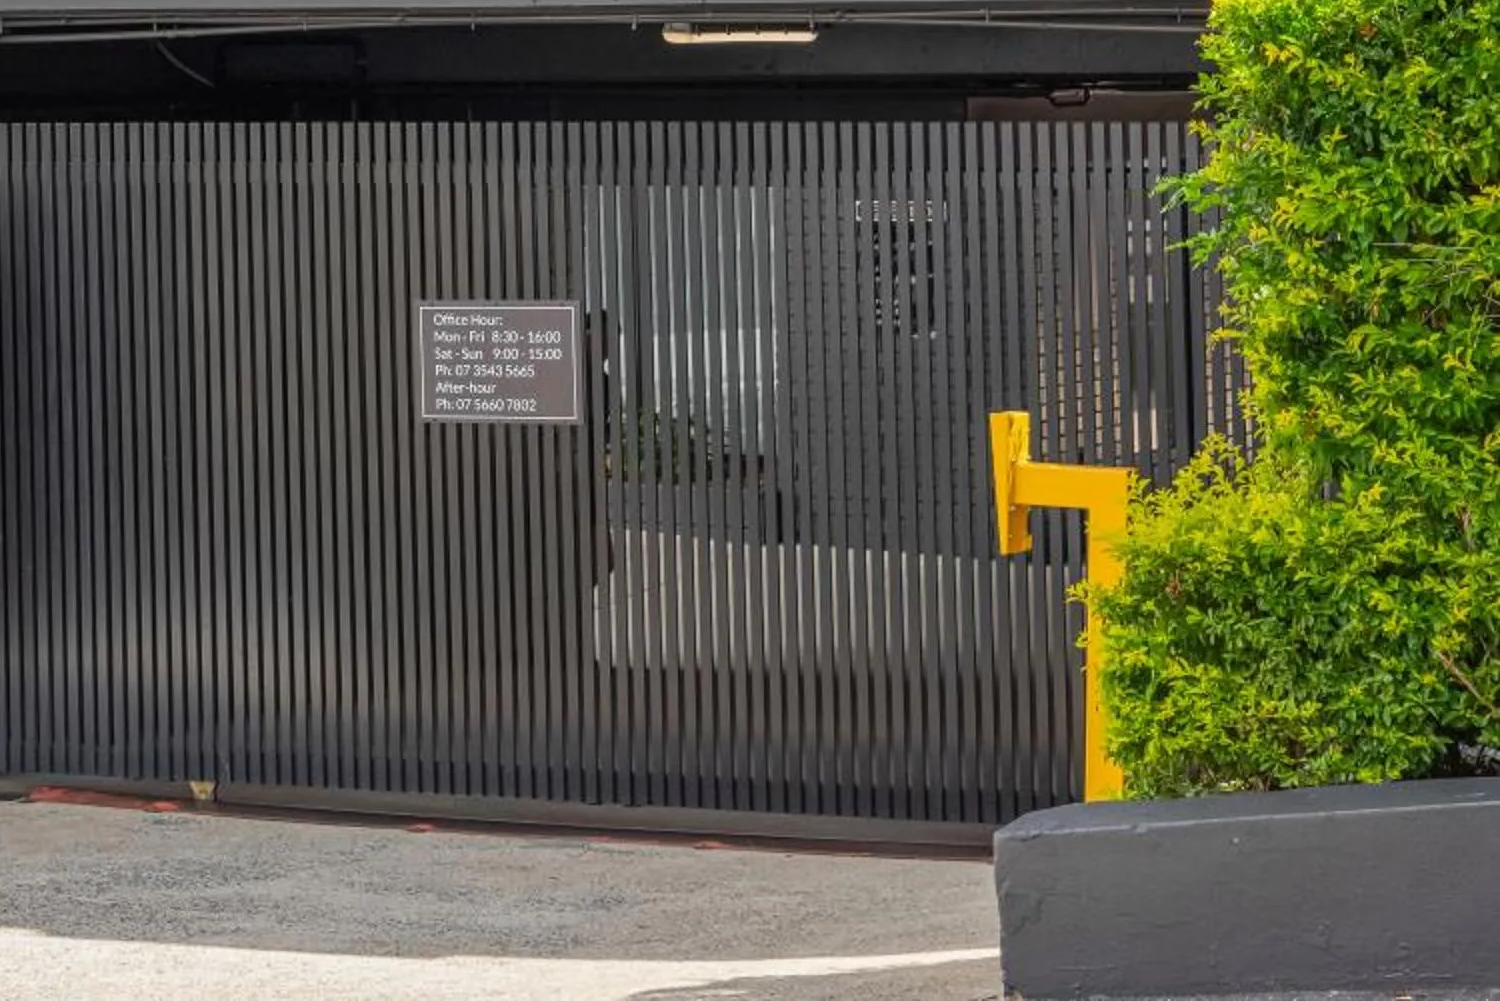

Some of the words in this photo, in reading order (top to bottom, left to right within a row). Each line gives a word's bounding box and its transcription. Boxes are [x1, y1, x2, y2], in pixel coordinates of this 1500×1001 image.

[433, 313, 469, 326] Office
[435, 330, 461, 343] Mon
[469, 330, 485, 343] Fri
[491, 330, 519, 344] 8:30
[528, 330, 561, 344] 16:00
[435, 347, 453, 360] Sat
[461, 347, 483, 360] Sun
[435, 364, 453, 376] Ph:
[455, 364, 471, 376] 07
[473, 364, 503, 378] 3543
[435, 380, 497, 394] After-hour
[436, 398, 455, 411] Ph:
[456, 398, 472, 411] 07
